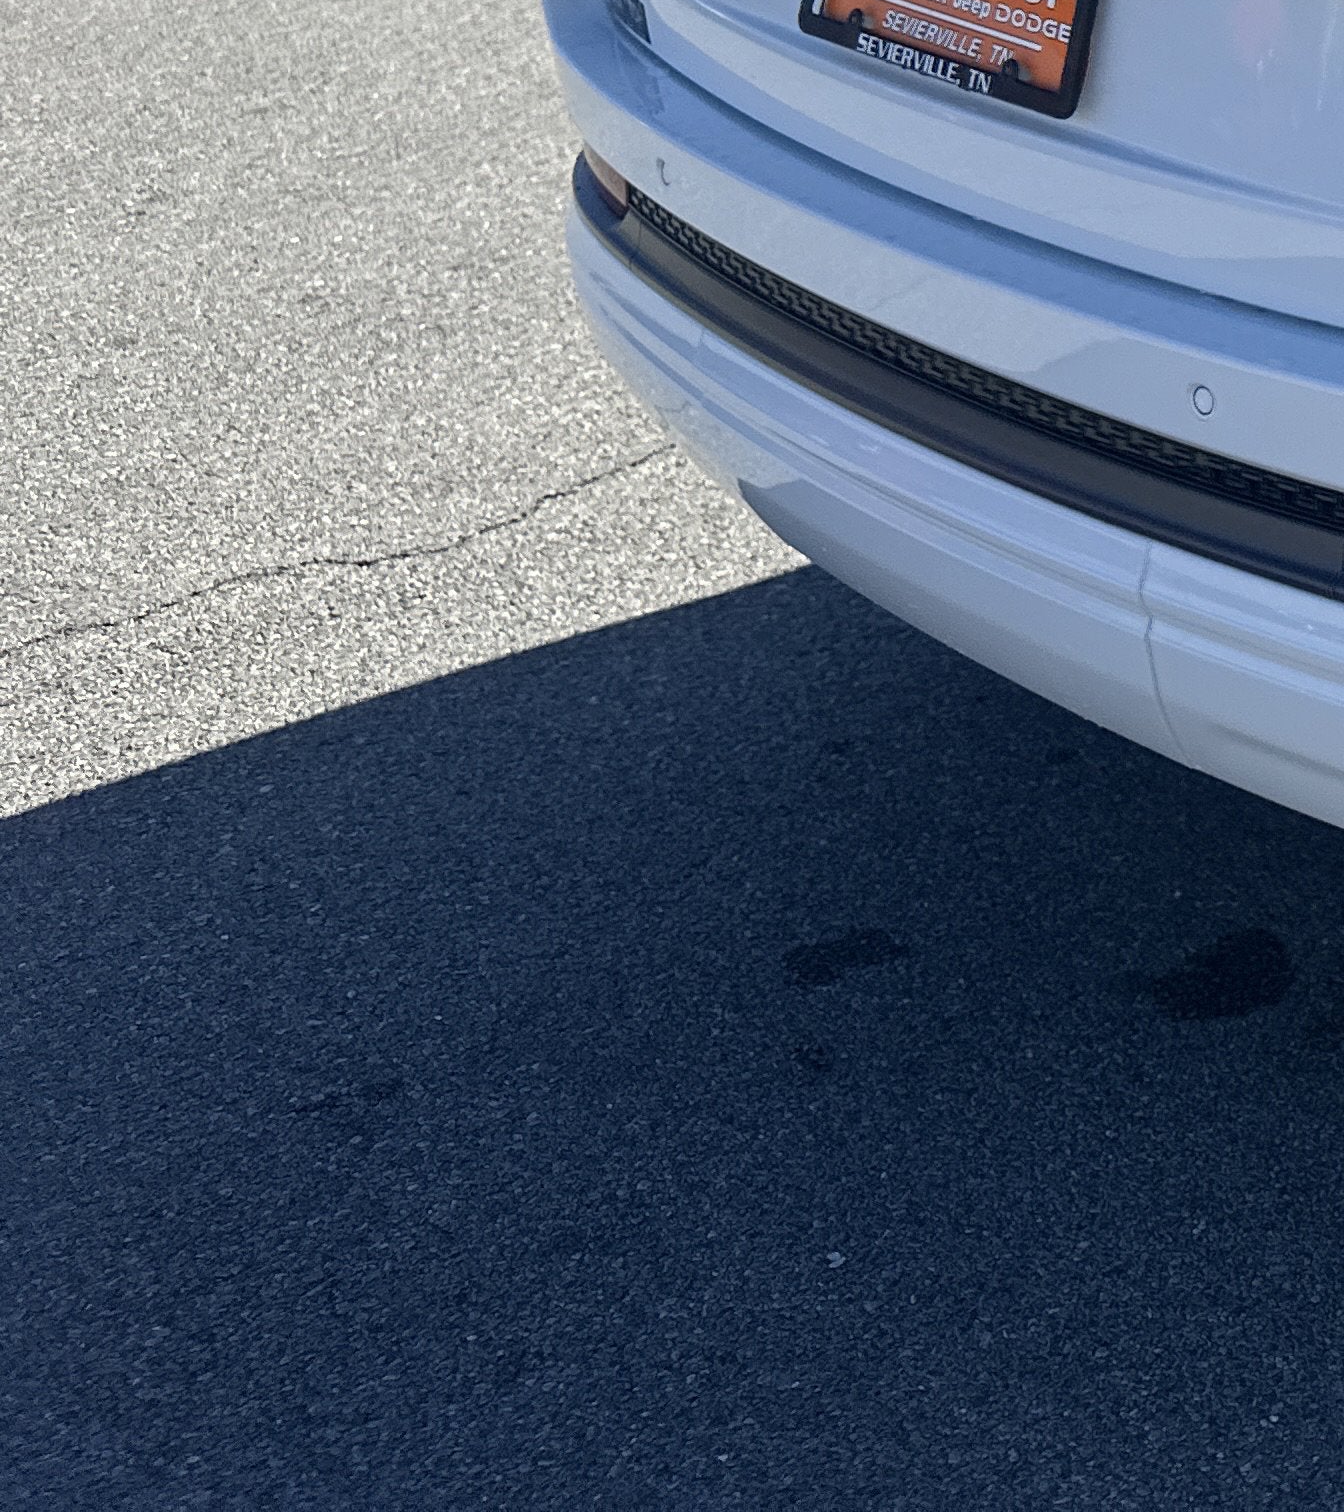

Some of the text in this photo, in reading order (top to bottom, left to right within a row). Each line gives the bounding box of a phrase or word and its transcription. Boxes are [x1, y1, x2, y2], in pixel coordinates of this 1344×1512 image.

[882, 9, 1016, 66] SEVIERVILLE, TN
[994, 3, 1072, 44] DODGE
[856, 33, 993, 94] SEVIERVILLE, TN
